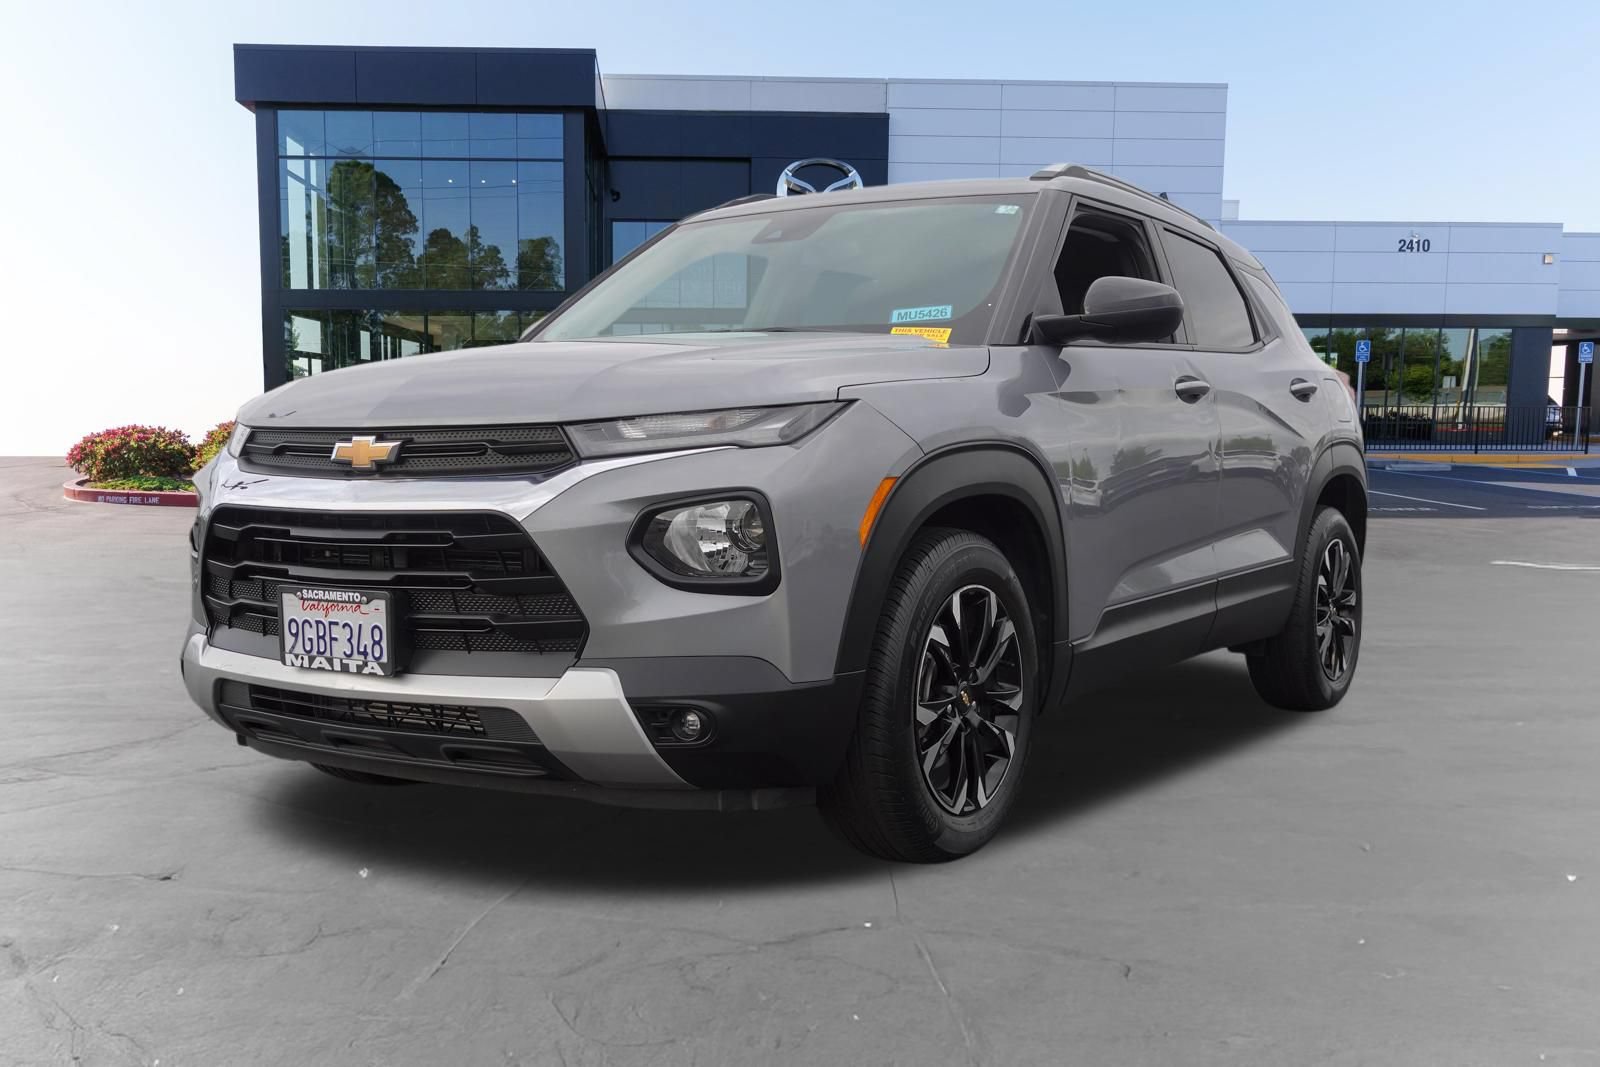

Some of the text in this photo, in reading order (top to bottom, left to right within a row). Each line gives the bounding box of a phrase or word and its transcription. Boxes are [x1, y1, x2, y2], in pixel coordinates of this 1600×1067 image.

[1398, 239, 1430, 252] 2410
[897, 308, 948, 321] MU5426
[106, 496, 127, 504] PARKING
[129, 496, 142, 504] FIRE
[144, 497, 160, 505] LANE
[302, 589, 361, 602] SACRAMENTO
[301, 599, 369, 618] California
[288, 617, 384, 662] 9GBF348
[285, 653, 385, 676] MAITA
